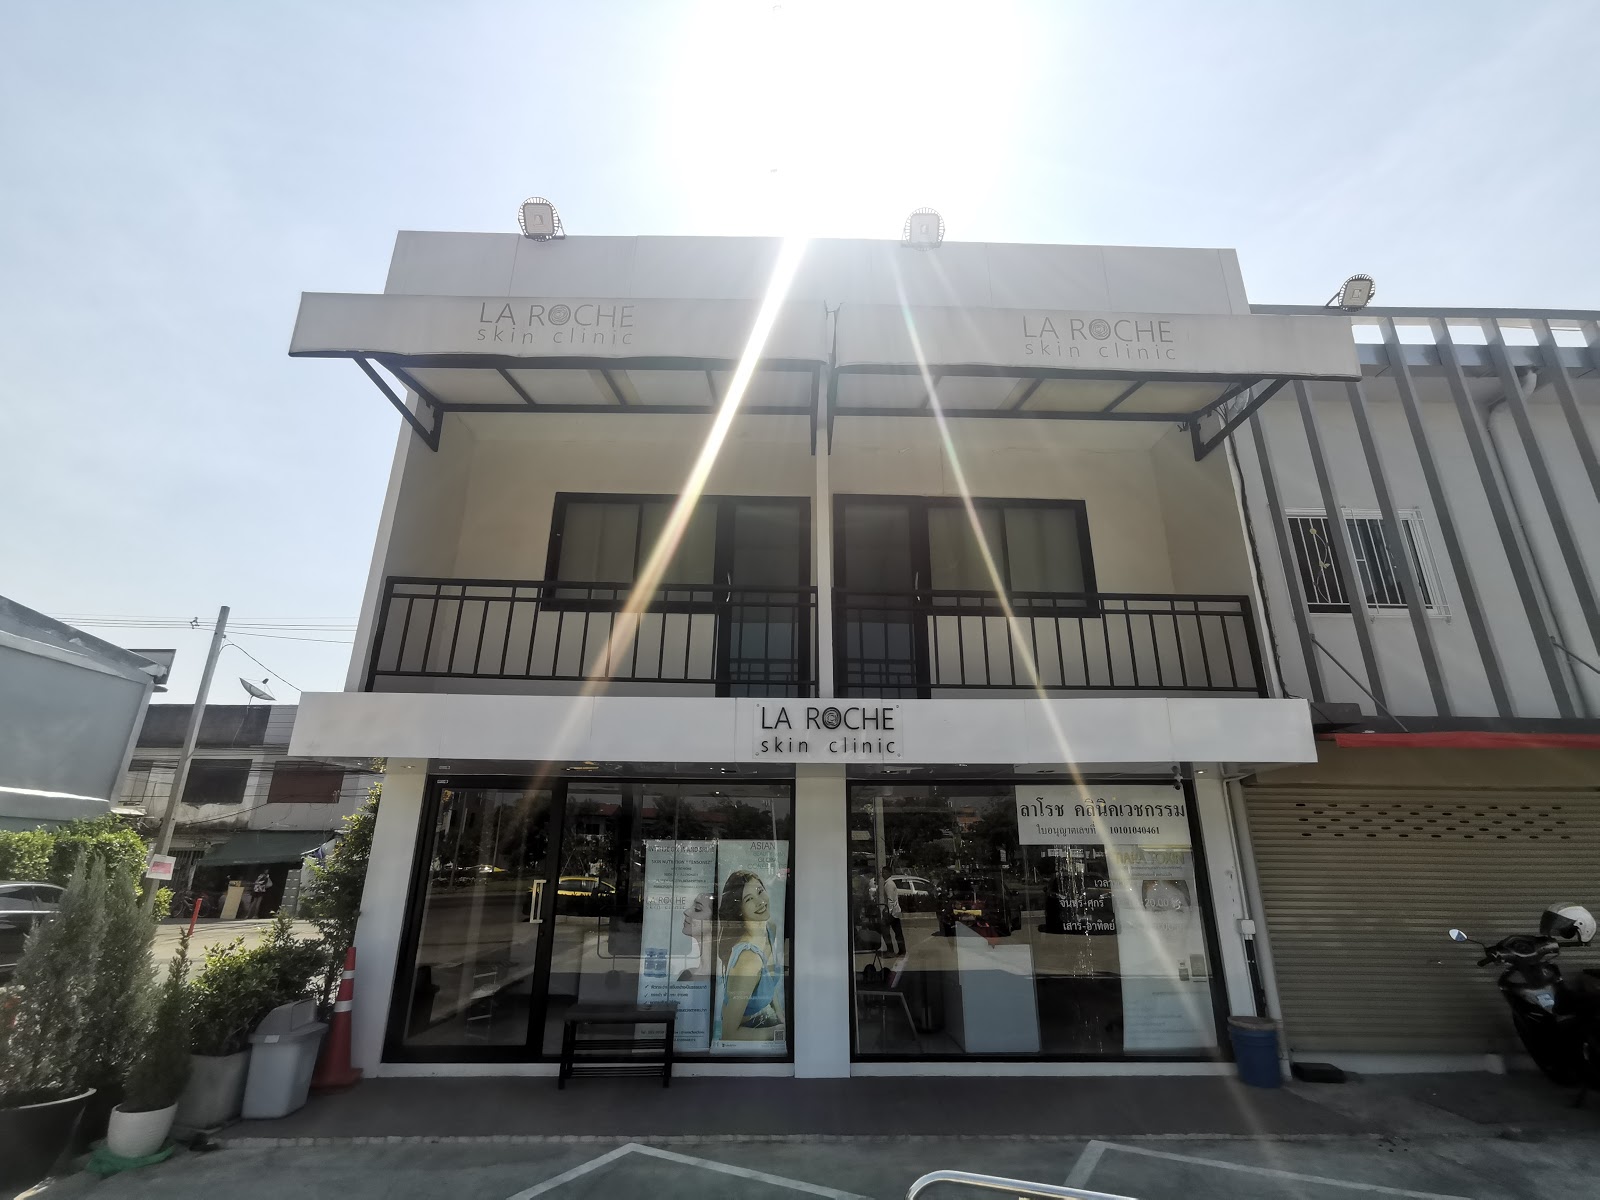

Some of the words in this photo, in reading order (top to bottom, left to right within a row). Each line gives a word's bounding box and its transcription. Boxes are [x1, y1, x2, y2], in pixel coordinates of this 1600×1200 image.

[480, 302, 516, 325] LA
[528, 303, 635, 328] ROCHE
[477, 325, 533, 345] skin
[553, 327, 632, 345] clinic
[1023, 315, 1059, 339] LA
[1070, 318, 1173, 343] ROCHE
[1025, 339, 1080, 358] skin
[1098, 342, 1176, 360] clinic
[761, 706, 792, 730] LA
[806, 706, 895, 730] ROCHE
[761, 736, 808, 753] skin
[829, 736, 895, 754] clinic
[1020, 797, 1064, 818] ลาโรช
[750, 841, 776, 850] ASIAN
[1063, 919, 1116, 932] เสาร์-อาทิตย์
